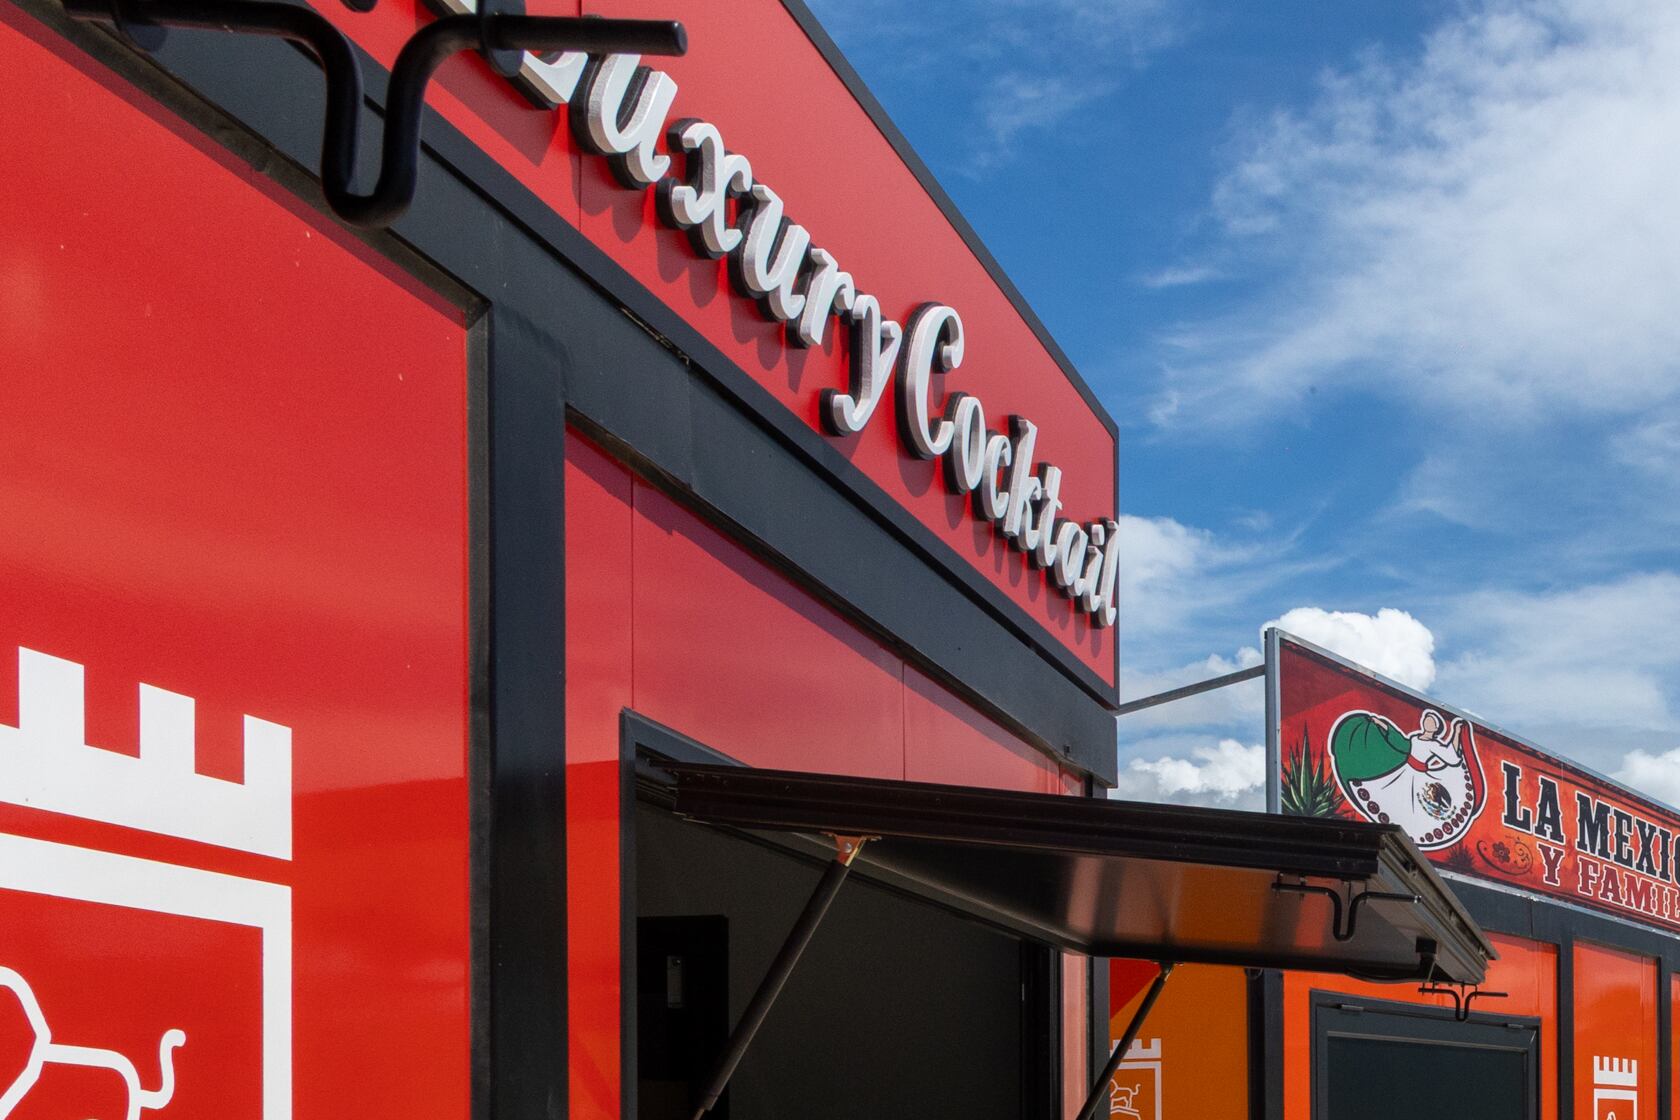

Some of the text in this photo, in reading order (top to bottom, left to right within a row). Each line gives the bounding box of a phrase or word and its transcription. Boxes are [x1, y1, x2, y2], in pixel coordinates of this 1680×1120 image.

[437, 0, 1119, 626] uxury Cocktail
[1501, 759, 1565, 845] LA
[1537, 842, 1565, 887] Y
